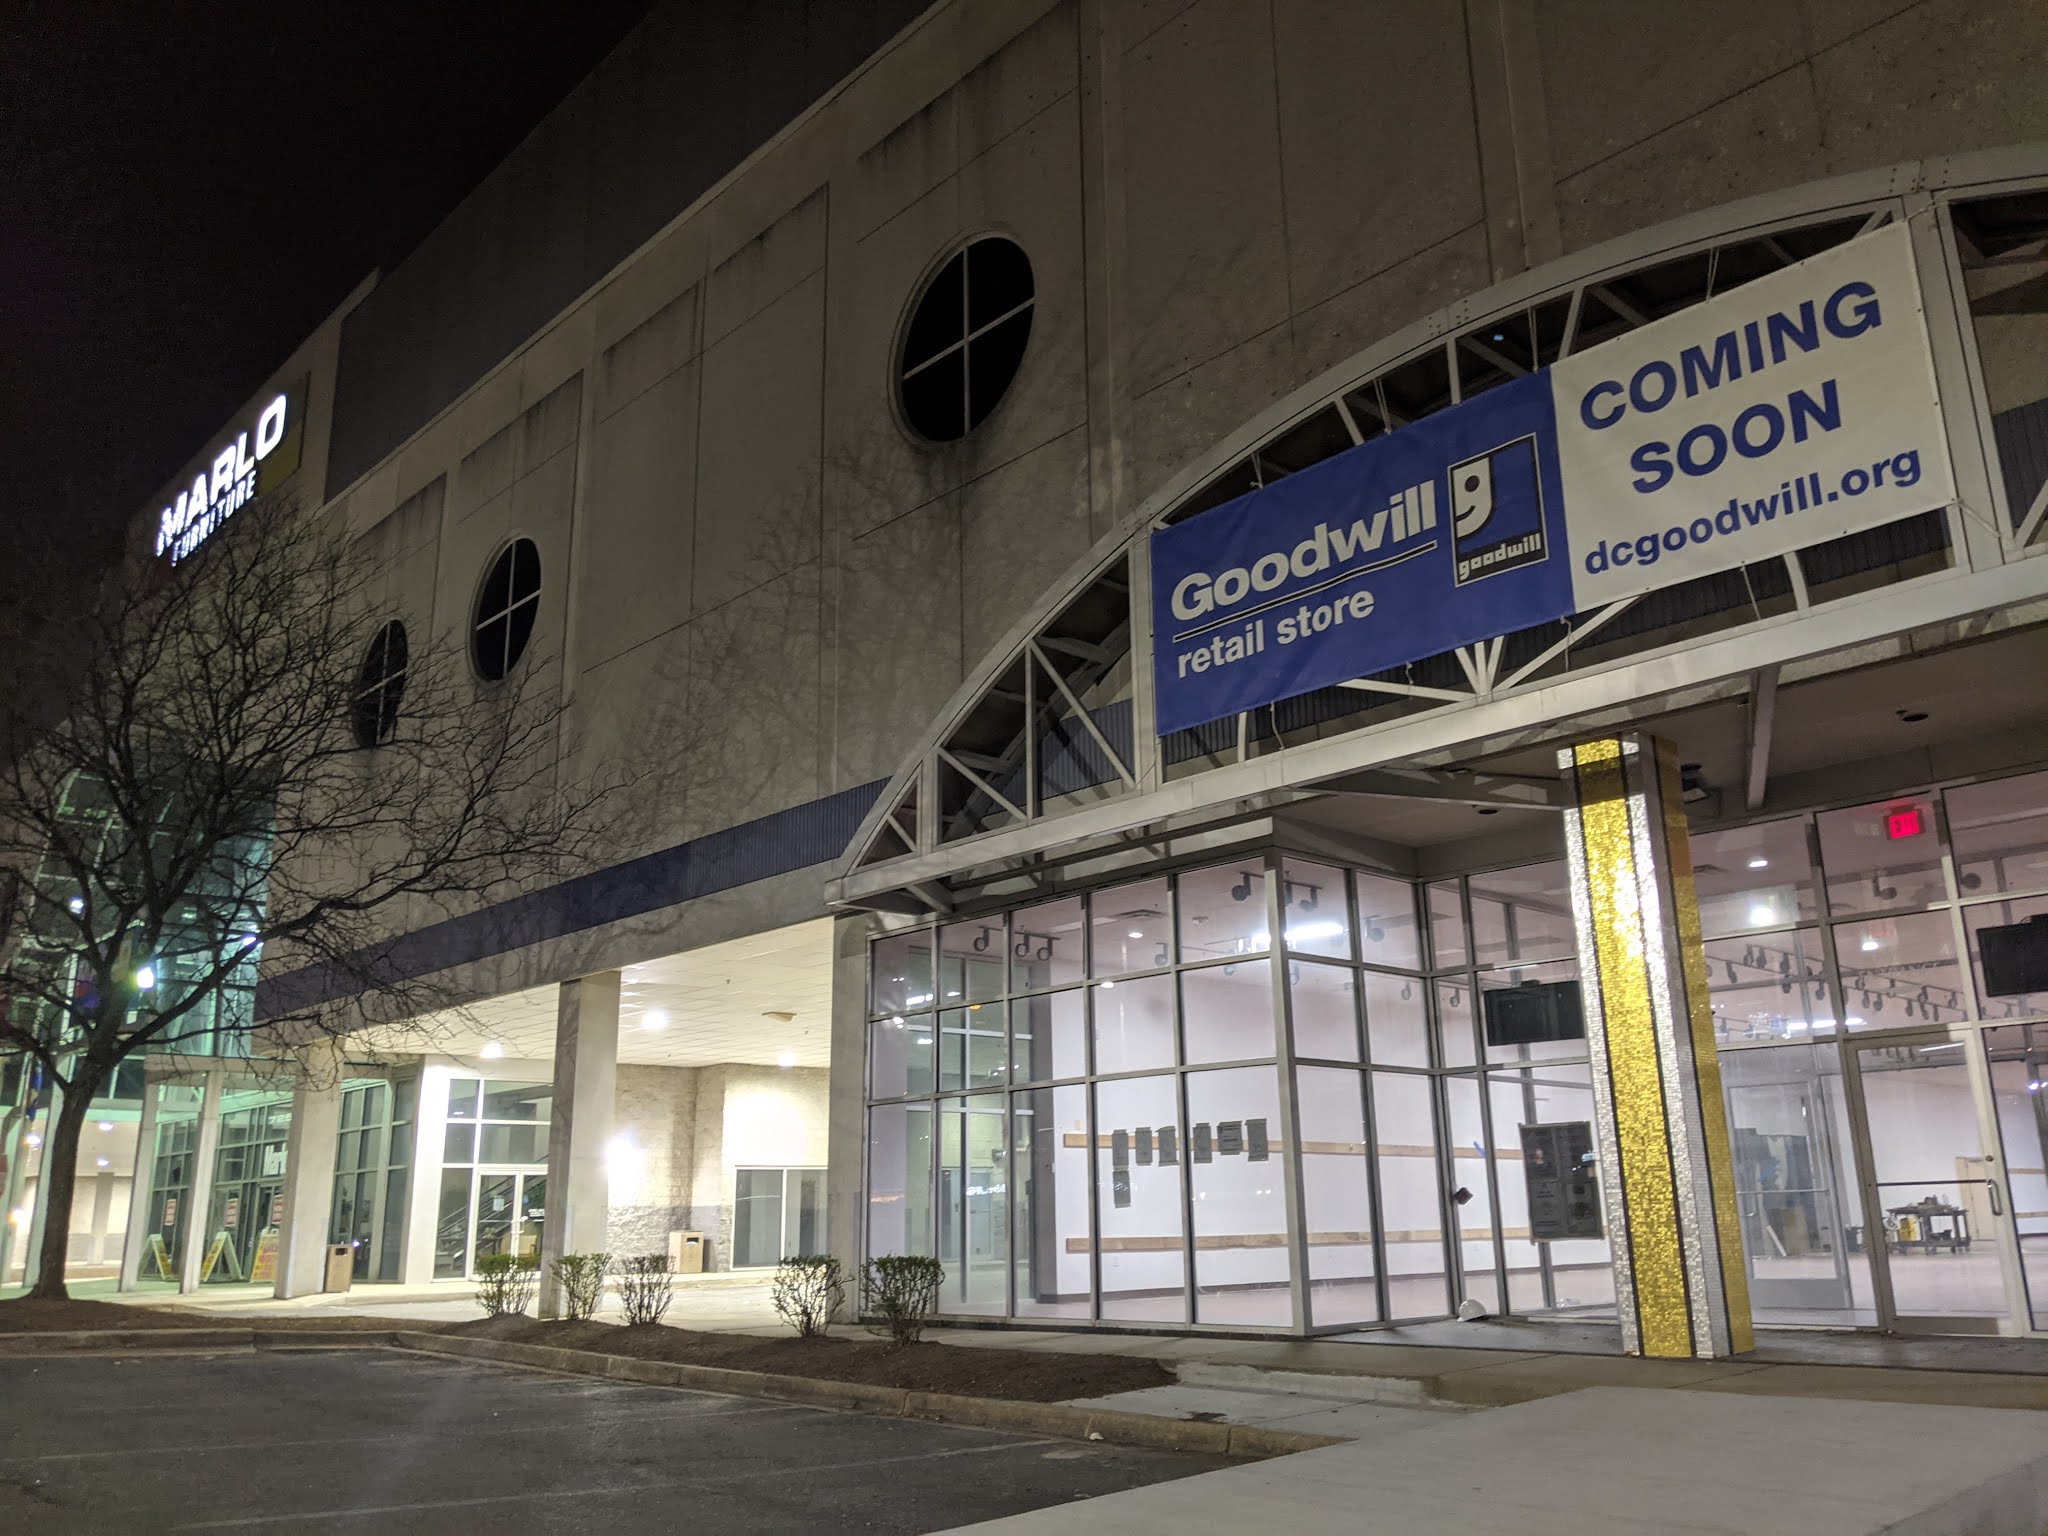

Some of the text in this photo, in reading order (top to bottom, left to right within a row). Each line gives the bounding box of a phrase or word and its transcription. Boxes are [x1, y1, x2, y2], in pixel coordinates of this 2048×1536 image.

[1580, 281, 1882, 430] COMING
[156, 394, 287, 557] MARLO
[1630, 378, 1842, 494] SOON
[1171, 480, 1437, 621] Goodwill
[1458, 532, 1542, 581] goodwill
[1585, 449, 1921, 574] dcgoodwill.org
[1178, 590, 1375, 679] retail store
